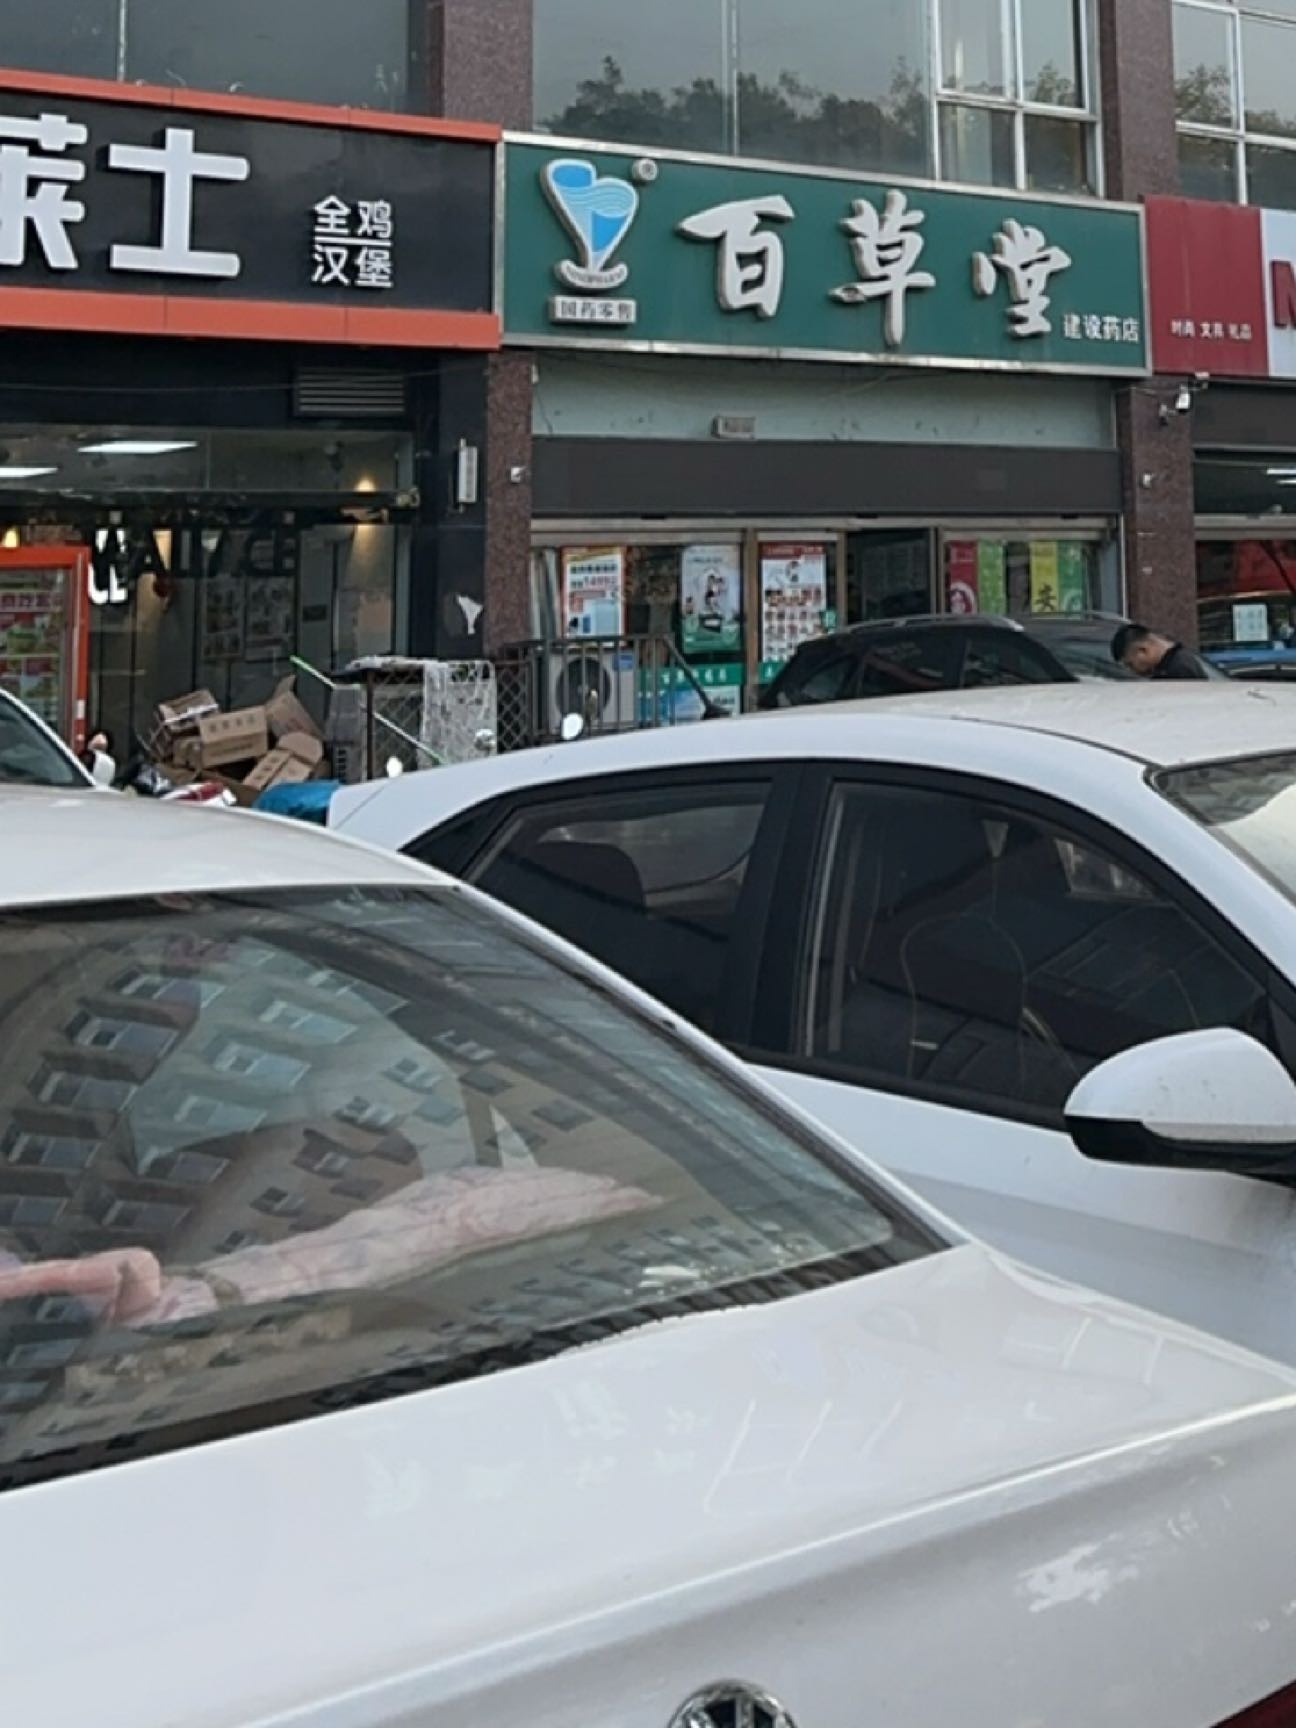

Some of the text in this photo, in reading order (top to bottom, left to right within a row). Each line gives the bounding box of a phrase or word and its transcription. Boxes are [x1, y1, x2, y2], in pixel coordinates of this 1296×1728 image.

[678, 190, 1072, 345] 百草堂
[1062, 313, 1140, 344] 建设药店
